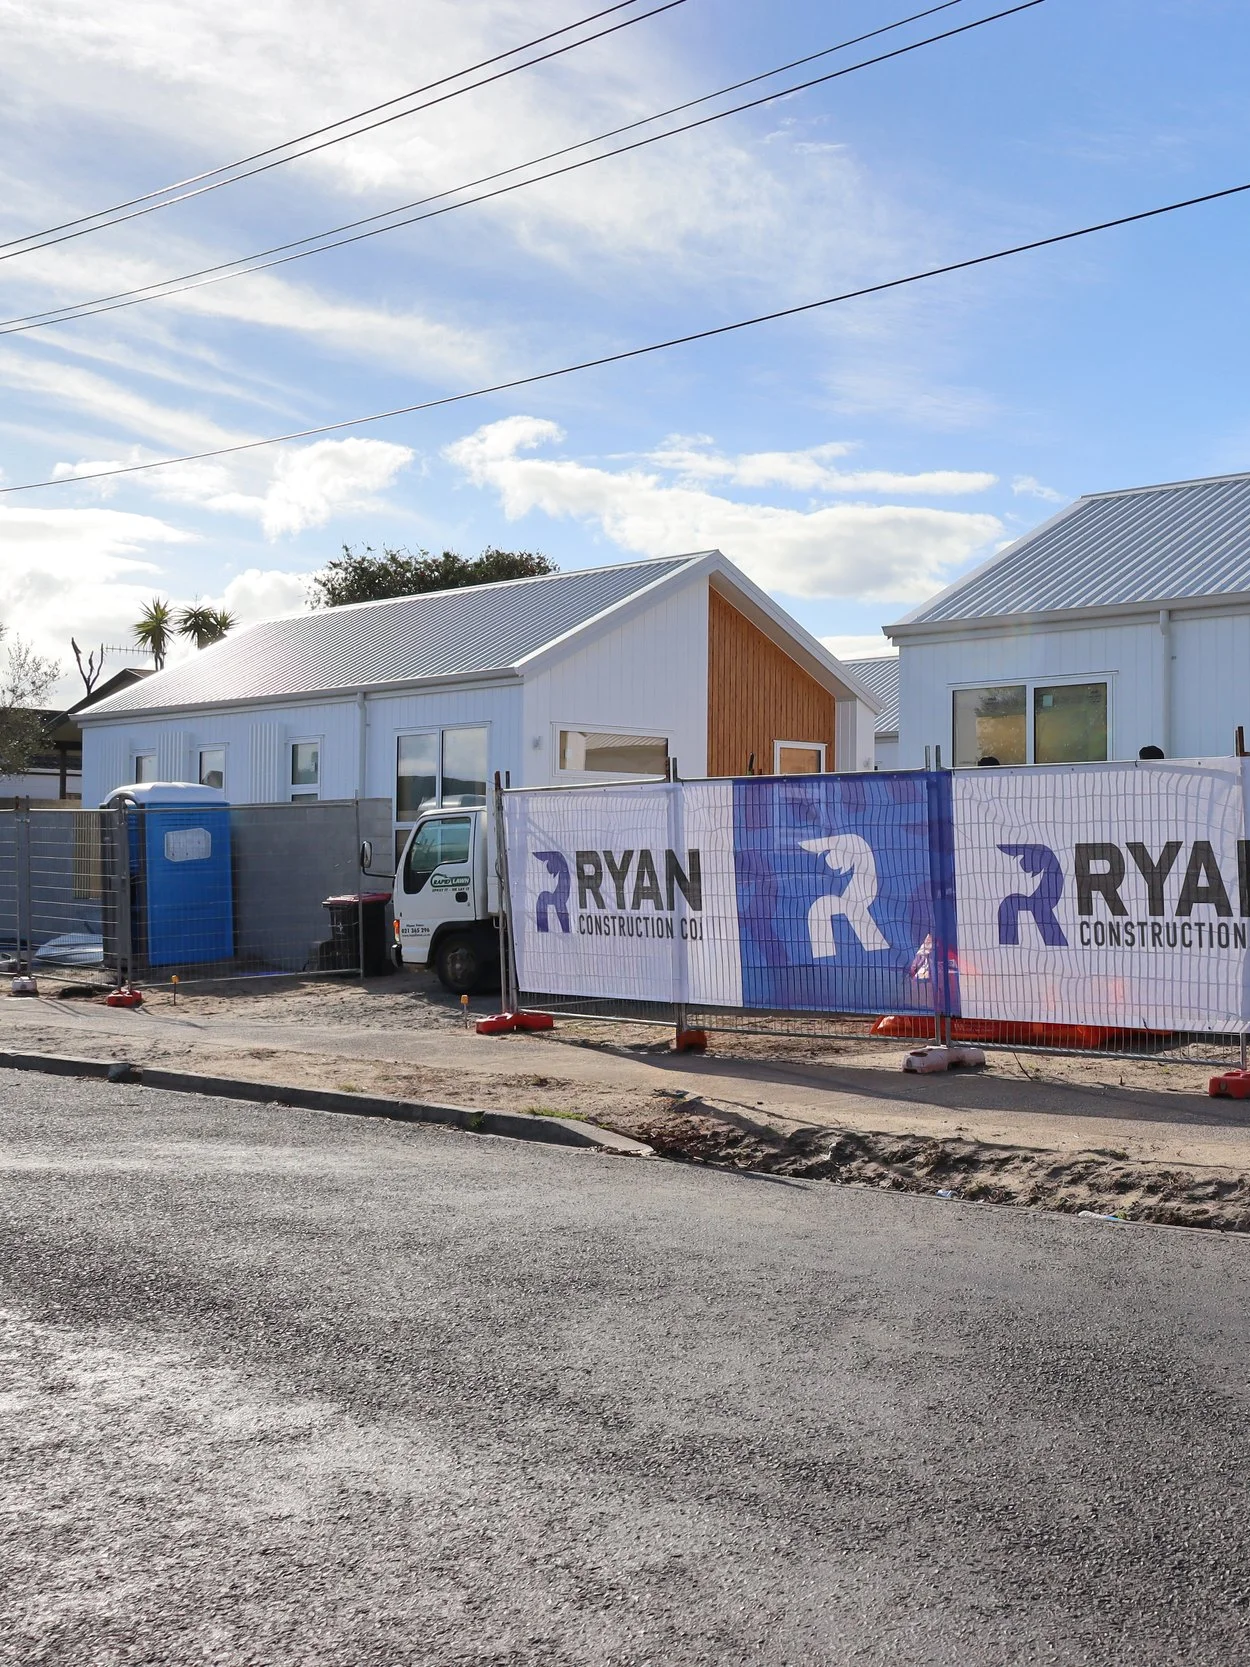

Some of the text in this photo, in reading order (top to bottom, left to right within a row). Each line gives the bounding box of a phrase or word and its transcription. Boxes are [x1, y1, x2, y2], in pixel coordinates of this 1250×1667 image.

[576, 849, 703, 911] RYAN
[579, 915, 674, 939] CONSTRUCTION
[1080, 921, 1246, 949] CONSTRUCTION
